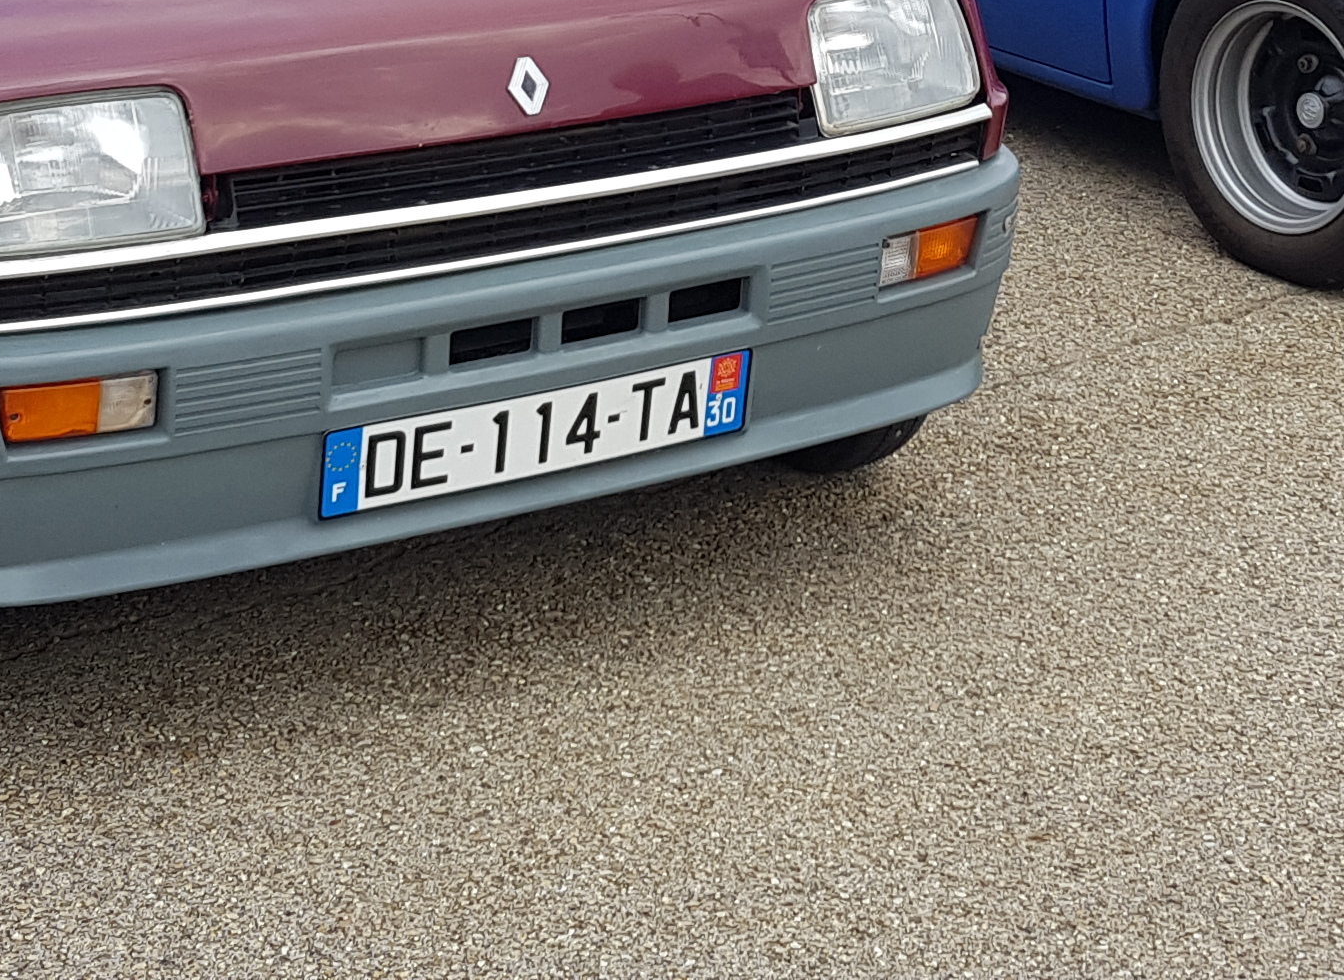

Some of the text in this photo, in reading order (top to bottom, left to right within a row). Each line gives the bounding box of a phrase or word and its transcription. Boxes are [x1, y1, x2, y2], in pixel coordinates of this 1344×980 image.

[706, 396, 737, 427] 30
[365, 370, 700, 499] DE-114-TA
[331, 481, 347, 503] F
